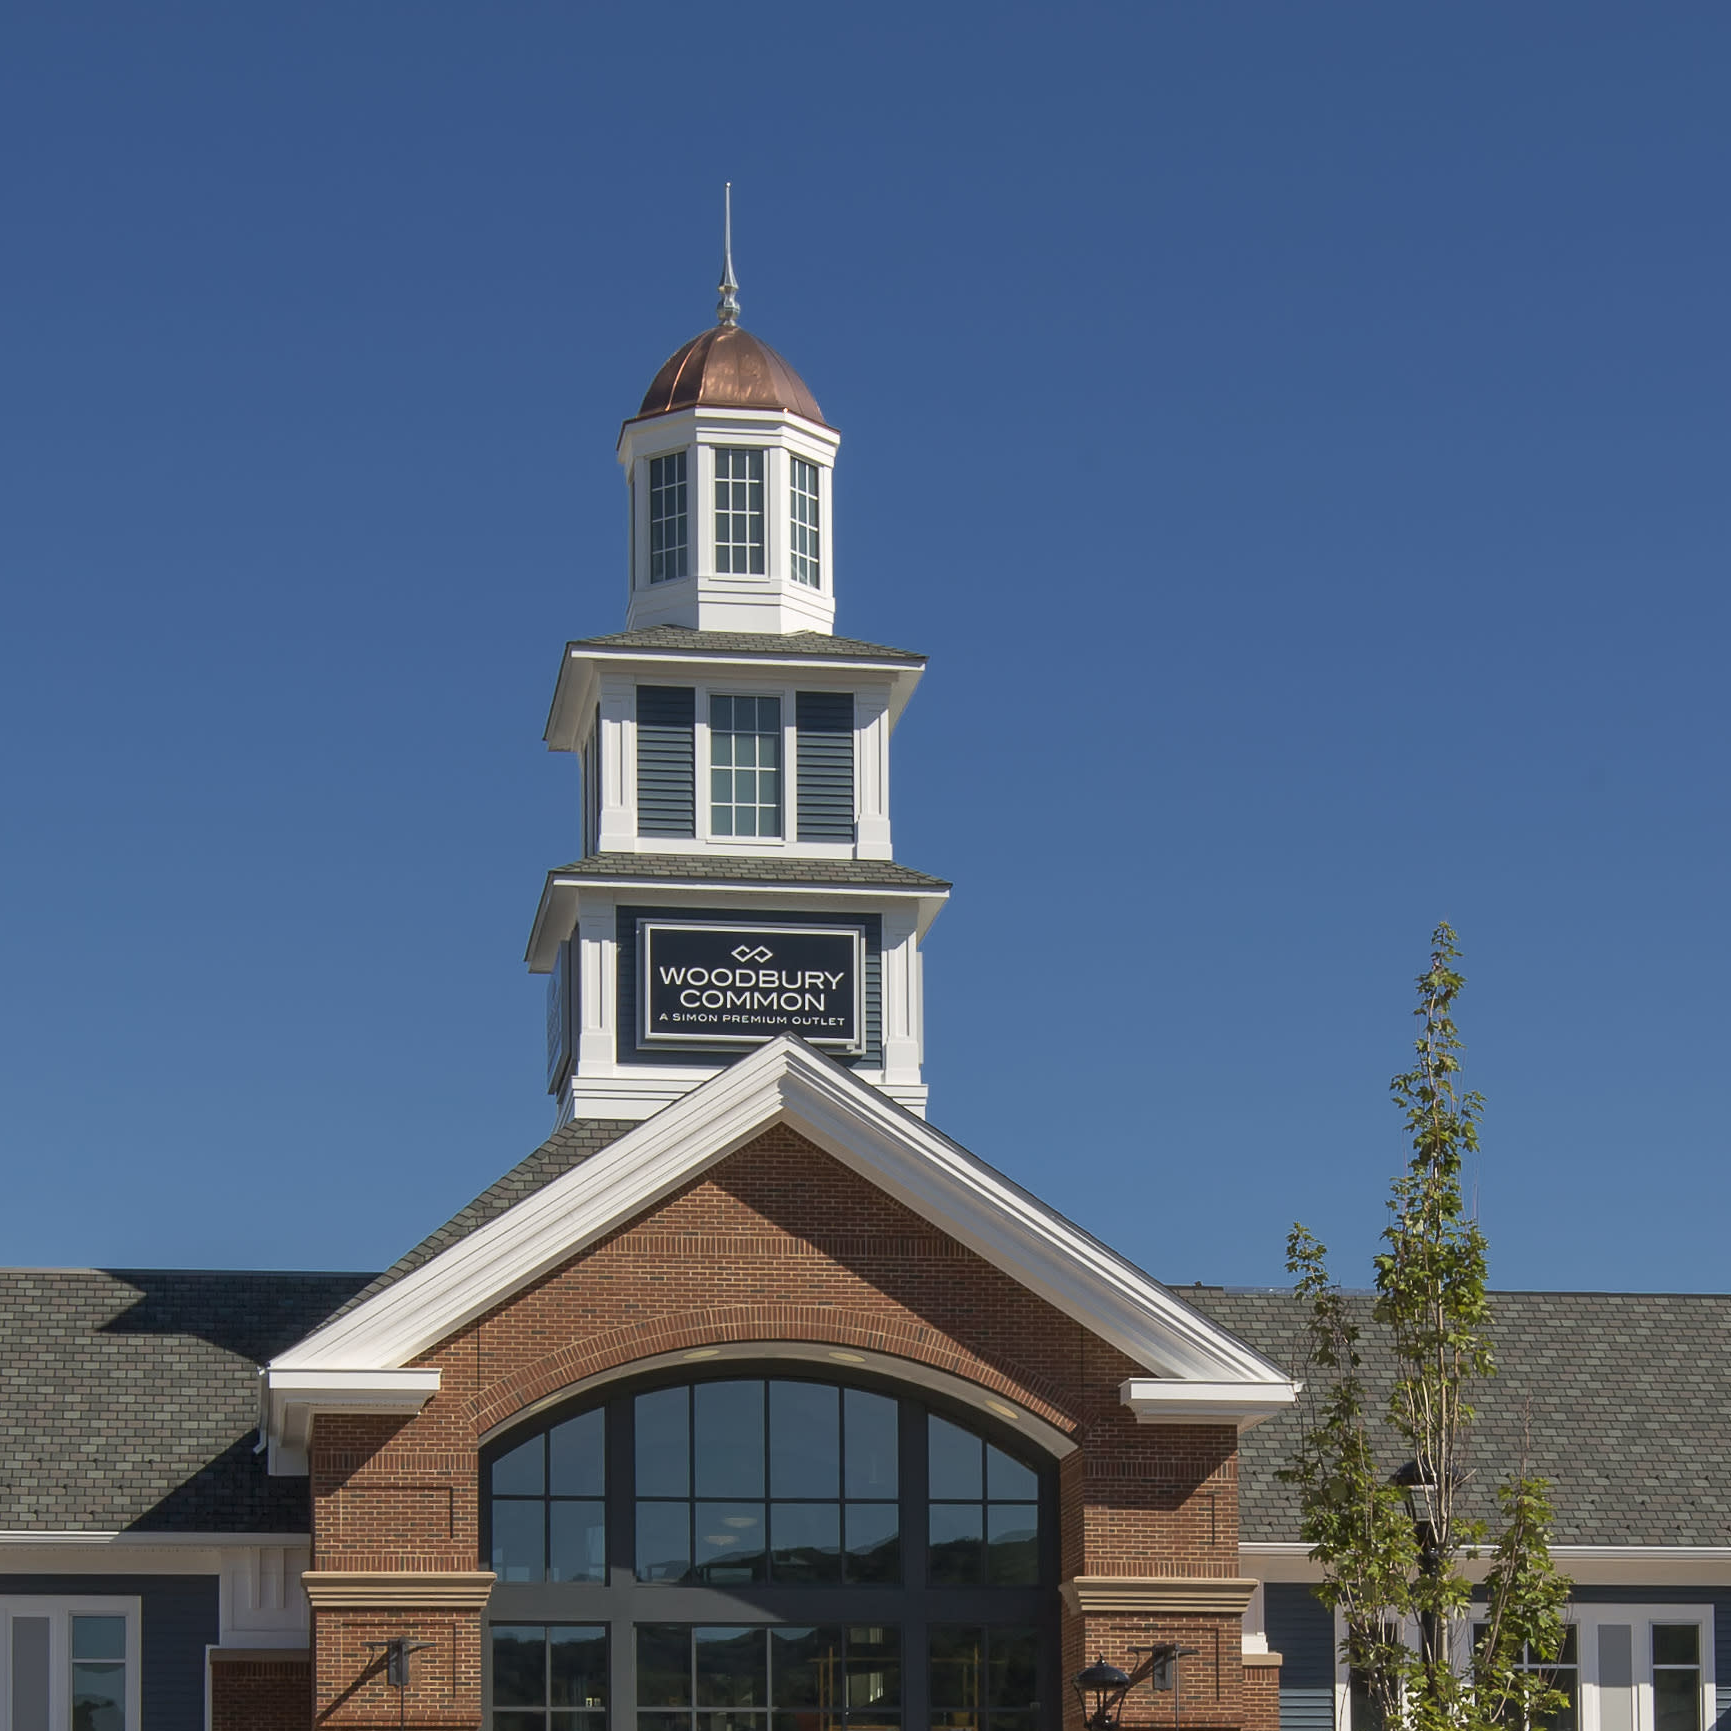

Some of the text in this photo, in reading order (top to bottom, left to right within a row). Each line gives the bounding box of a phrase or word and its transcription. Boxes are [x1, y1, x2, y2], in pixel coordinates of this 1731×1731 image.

[659, 966, 845, 990] WOODBURY
[679, 989, 826, 1012] COMMON
[659, 1012, 846, 1026] A SIMON PREMIUM OUTLET
